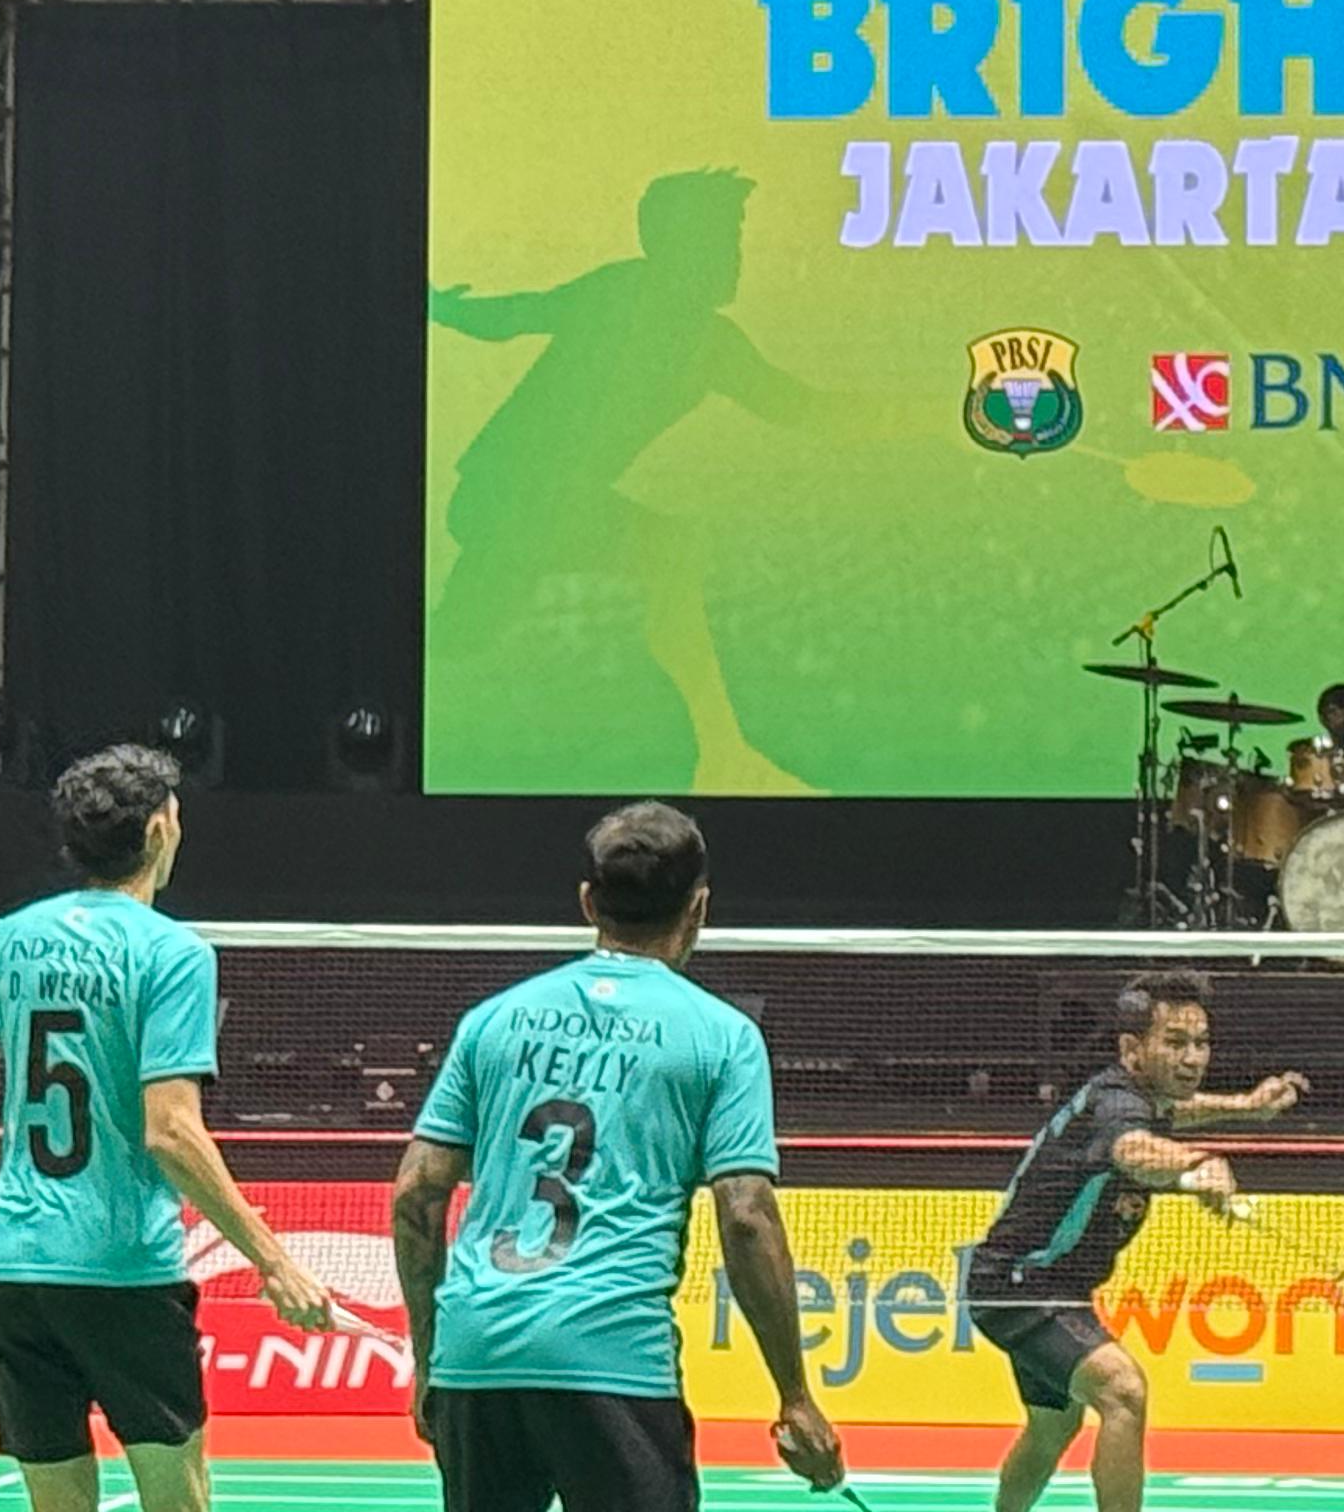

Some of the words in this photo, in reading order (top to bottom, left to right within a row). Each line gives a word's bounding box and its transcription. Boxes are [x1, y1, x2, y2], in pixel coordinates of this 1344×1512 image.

[990, 336, 1053, 374] PBSI
[39, 970, 121, 1008] WENAS
[514, 1040, 638, 1093] KELLY
[27, 1010, 93, 1179] 5
[489, 1098, 596, 1274] 3
